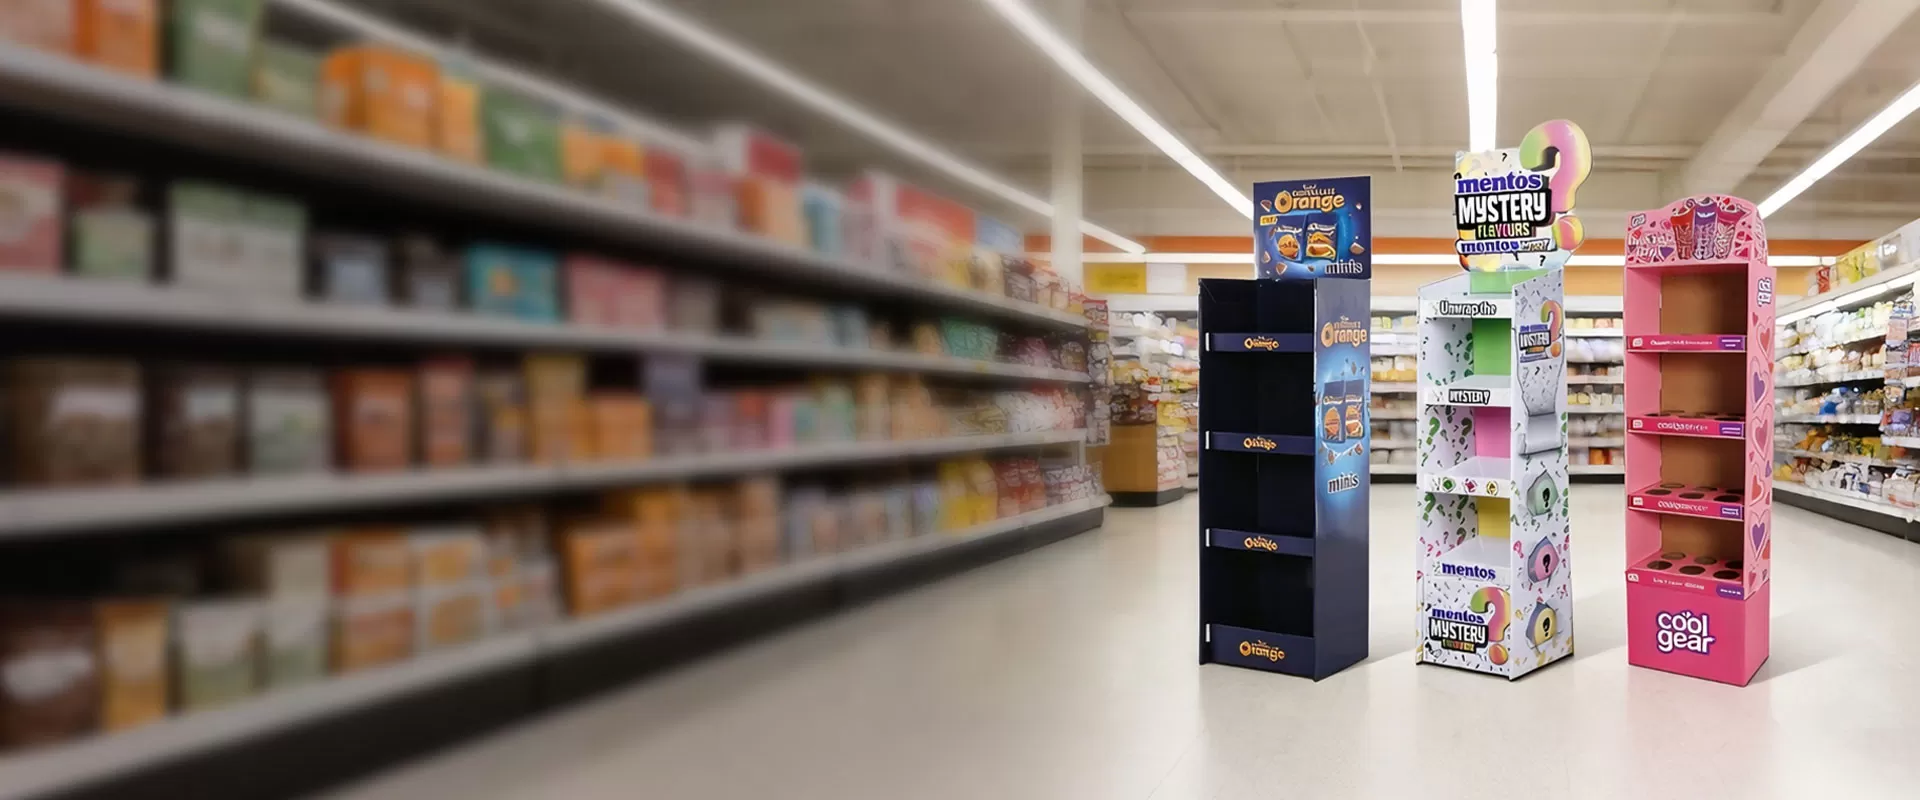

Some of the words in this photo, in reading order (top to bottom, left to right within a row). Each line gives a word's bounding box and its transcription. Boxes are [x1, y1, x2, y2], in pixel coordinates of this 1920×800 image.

[1457, 171, 1542, 194] mentos
[1274, 190, 1345, 212] Orange
[1458, 192, 1547, 225] MYSTERY
[1477, 222, 1530, 238] FLAVOURS
[1244, 337, 1280, 351] Oge
[1320, 322, 1368, 347] Orange
[1328, 471, 1360, 493] minis
[1441, 562, 1497, 580] mentos
[1431, 608, 1485, 624] mentos
[1657, 611, 1708, 637] cool
[1430, 618, 1486, 645] MYSTERY
[1657, 630, 1716, 654] gear
[1239, 640, 1286, 662] Orange
